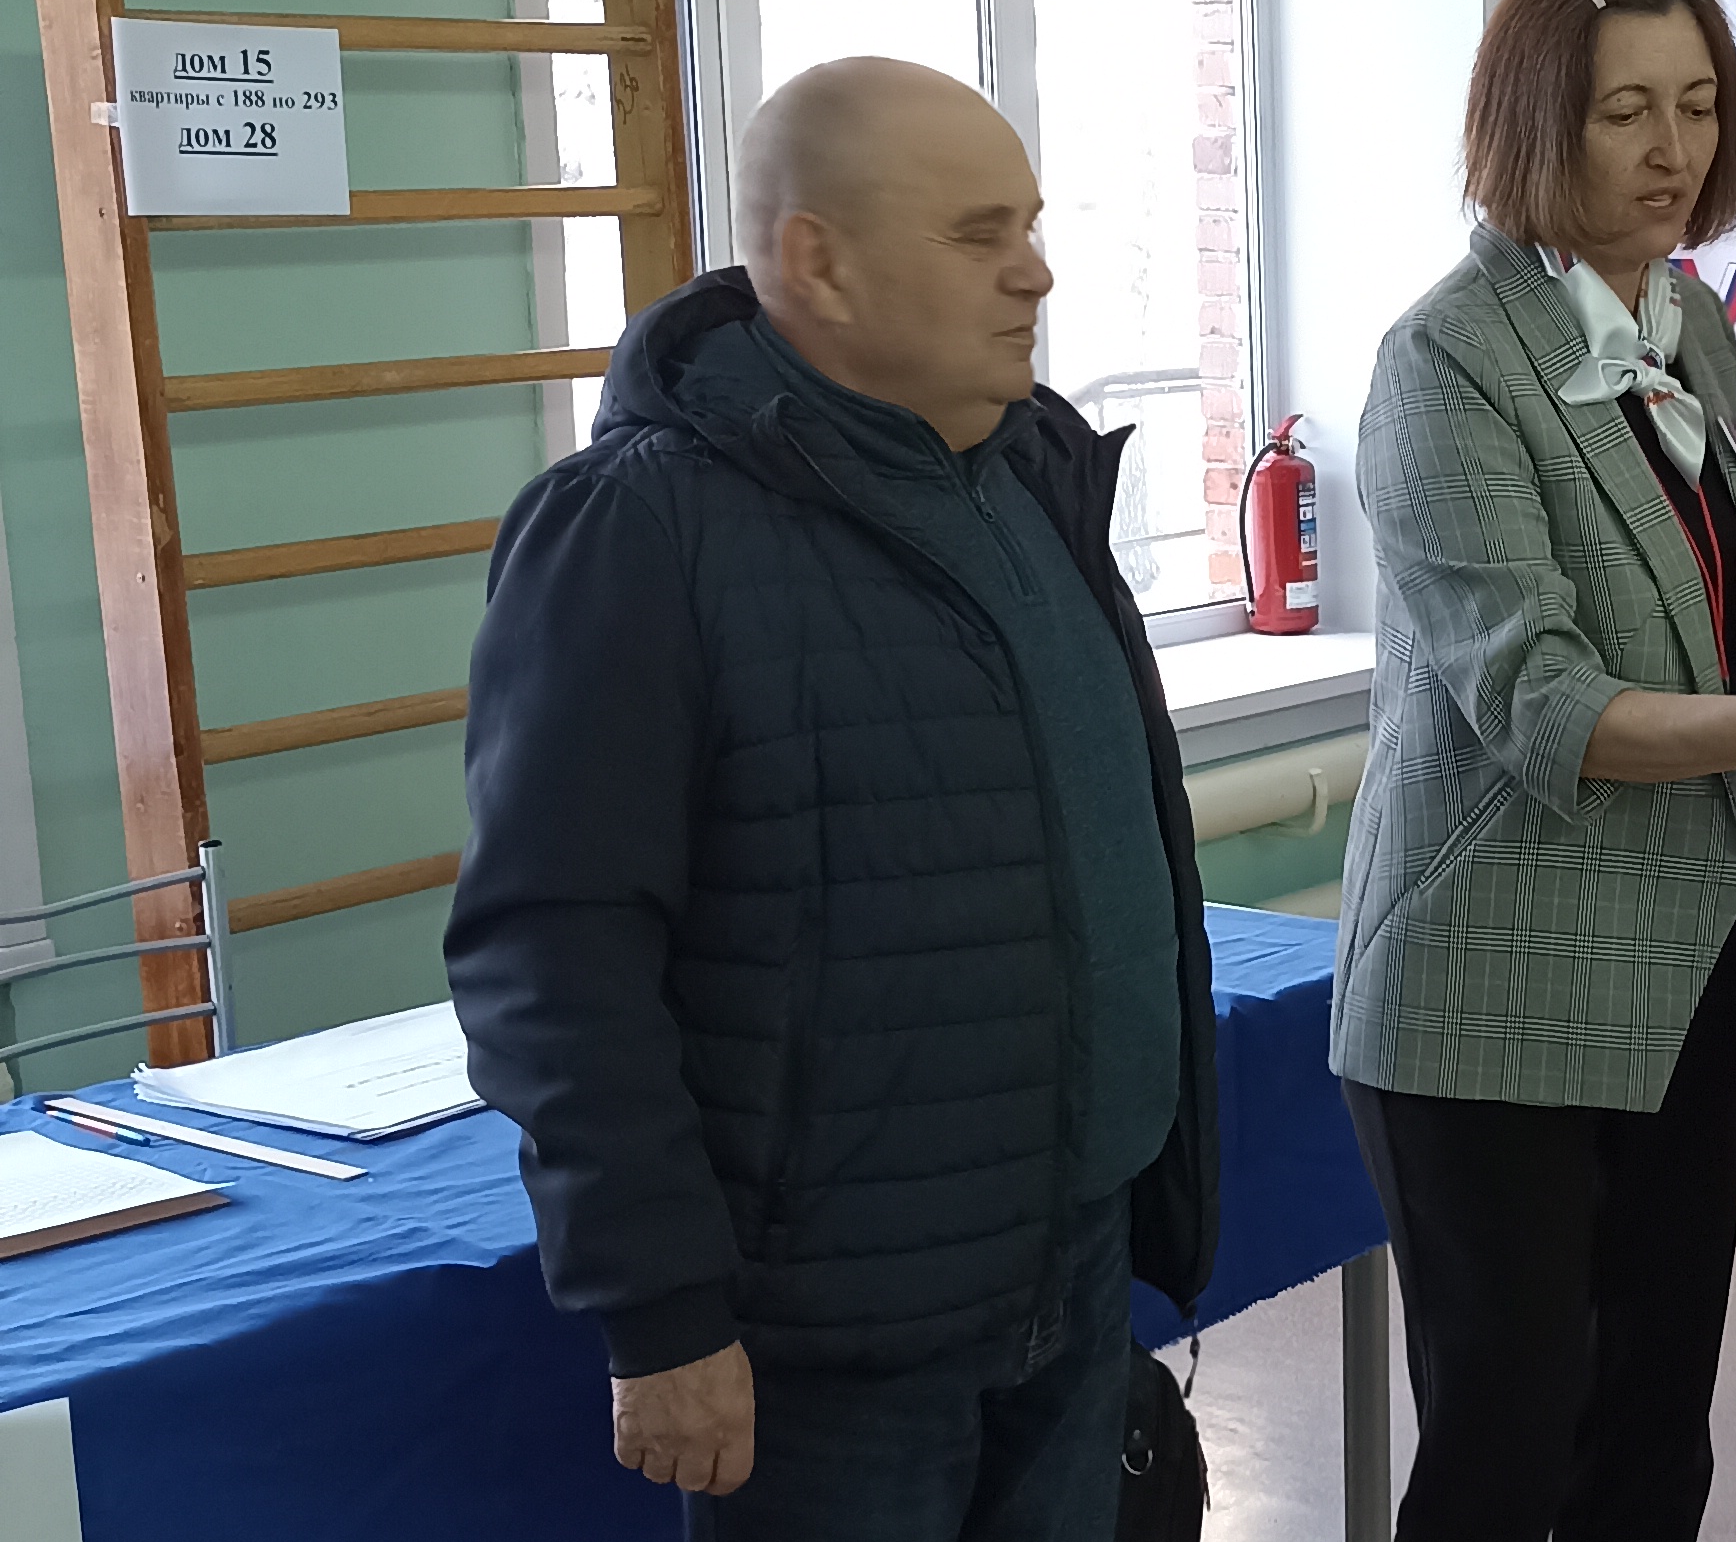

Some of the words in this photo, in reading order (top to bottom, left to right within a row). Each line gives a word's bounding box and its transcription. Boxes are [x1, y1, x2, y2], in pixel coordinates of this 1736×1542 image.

[174, 52, 227, 77] дом
[240, 49, 273, 77] 15
[129, 88, 211, 109] квартиры
[232, 89, 265, 108] 188
[272, 95, 296, 109] по
[302, 91, 338, 111] 293
[178, 127, 232, 150] дом
[242, 122, 277, 150] 28
